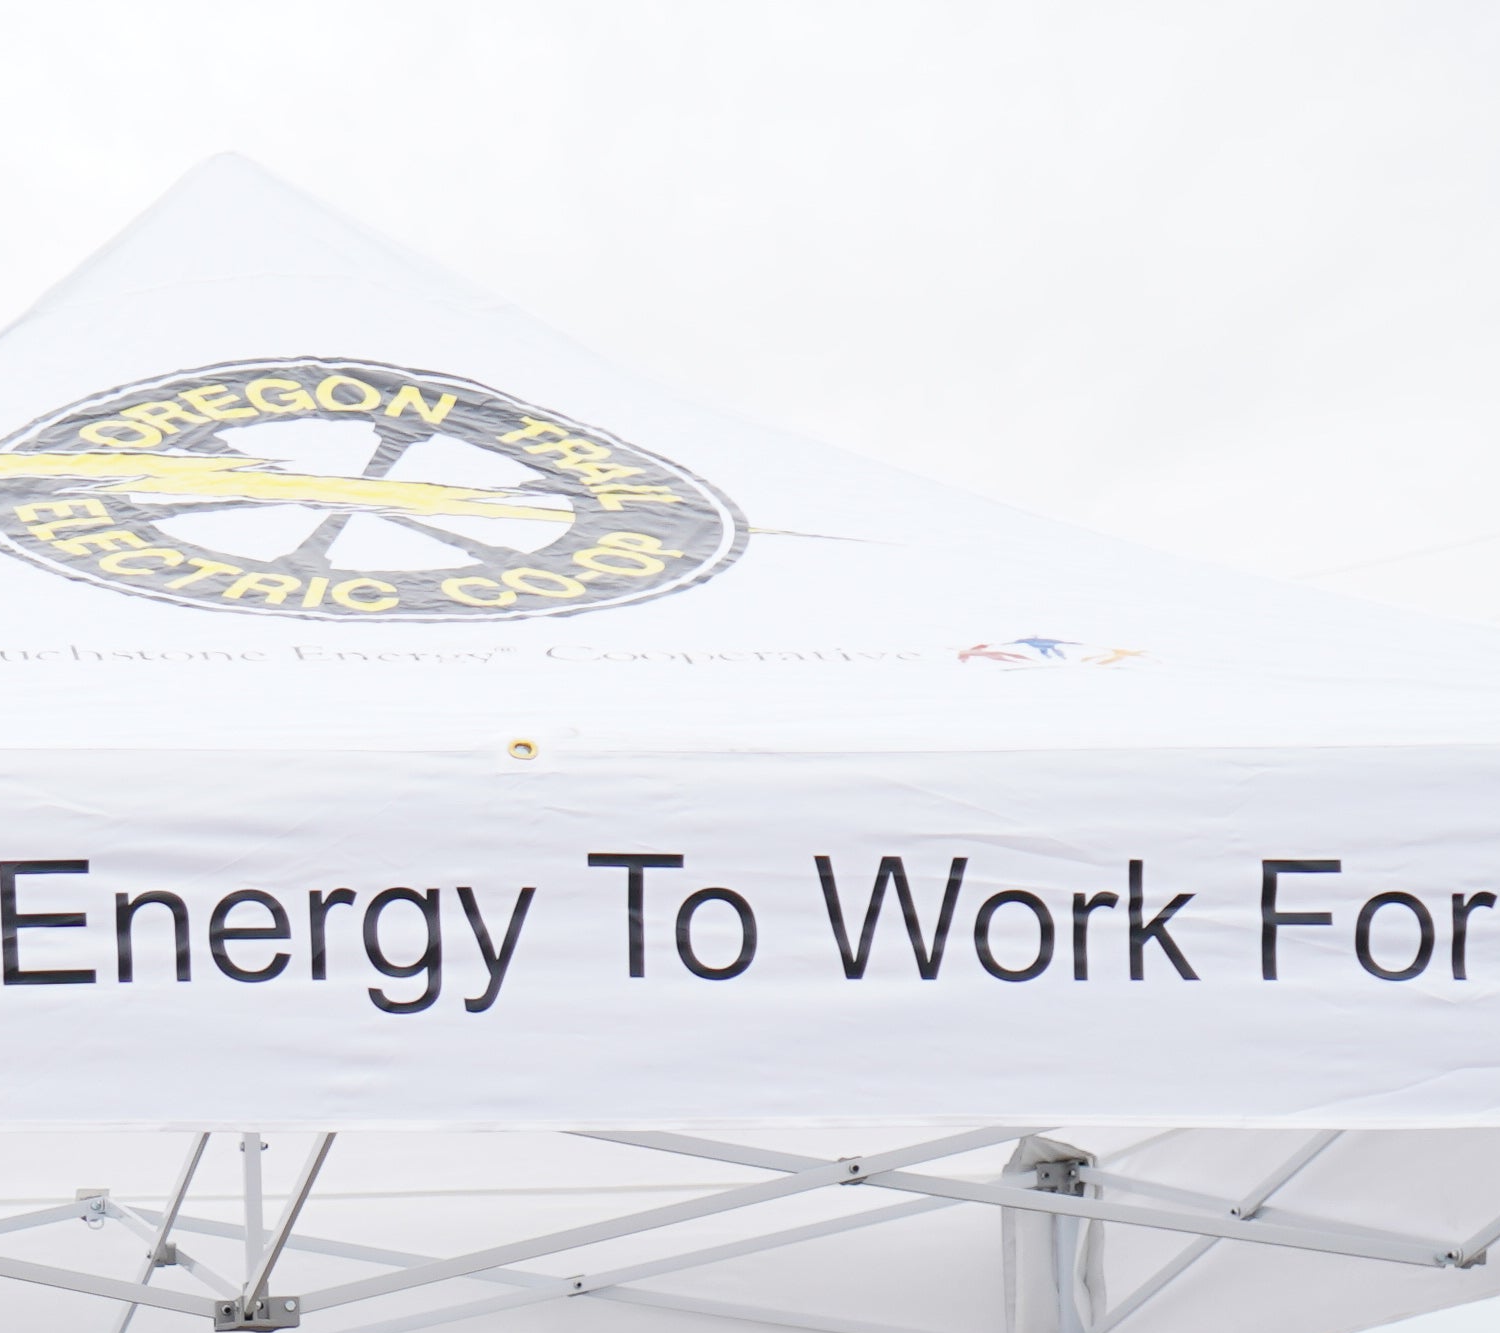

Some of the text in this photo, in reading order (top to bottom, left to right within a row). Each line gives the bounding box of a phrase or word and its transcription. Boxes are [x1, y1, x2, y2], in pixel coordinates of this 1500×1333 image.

[78, 374, 682, 511] OREGON TRAIL
[14, 494, 683, 612] ELECTRIC CO-OP
[585, 851, 758, 982] To
[812, 853, 1200, 983] Work
[1258, 857, 1498, 982] For
